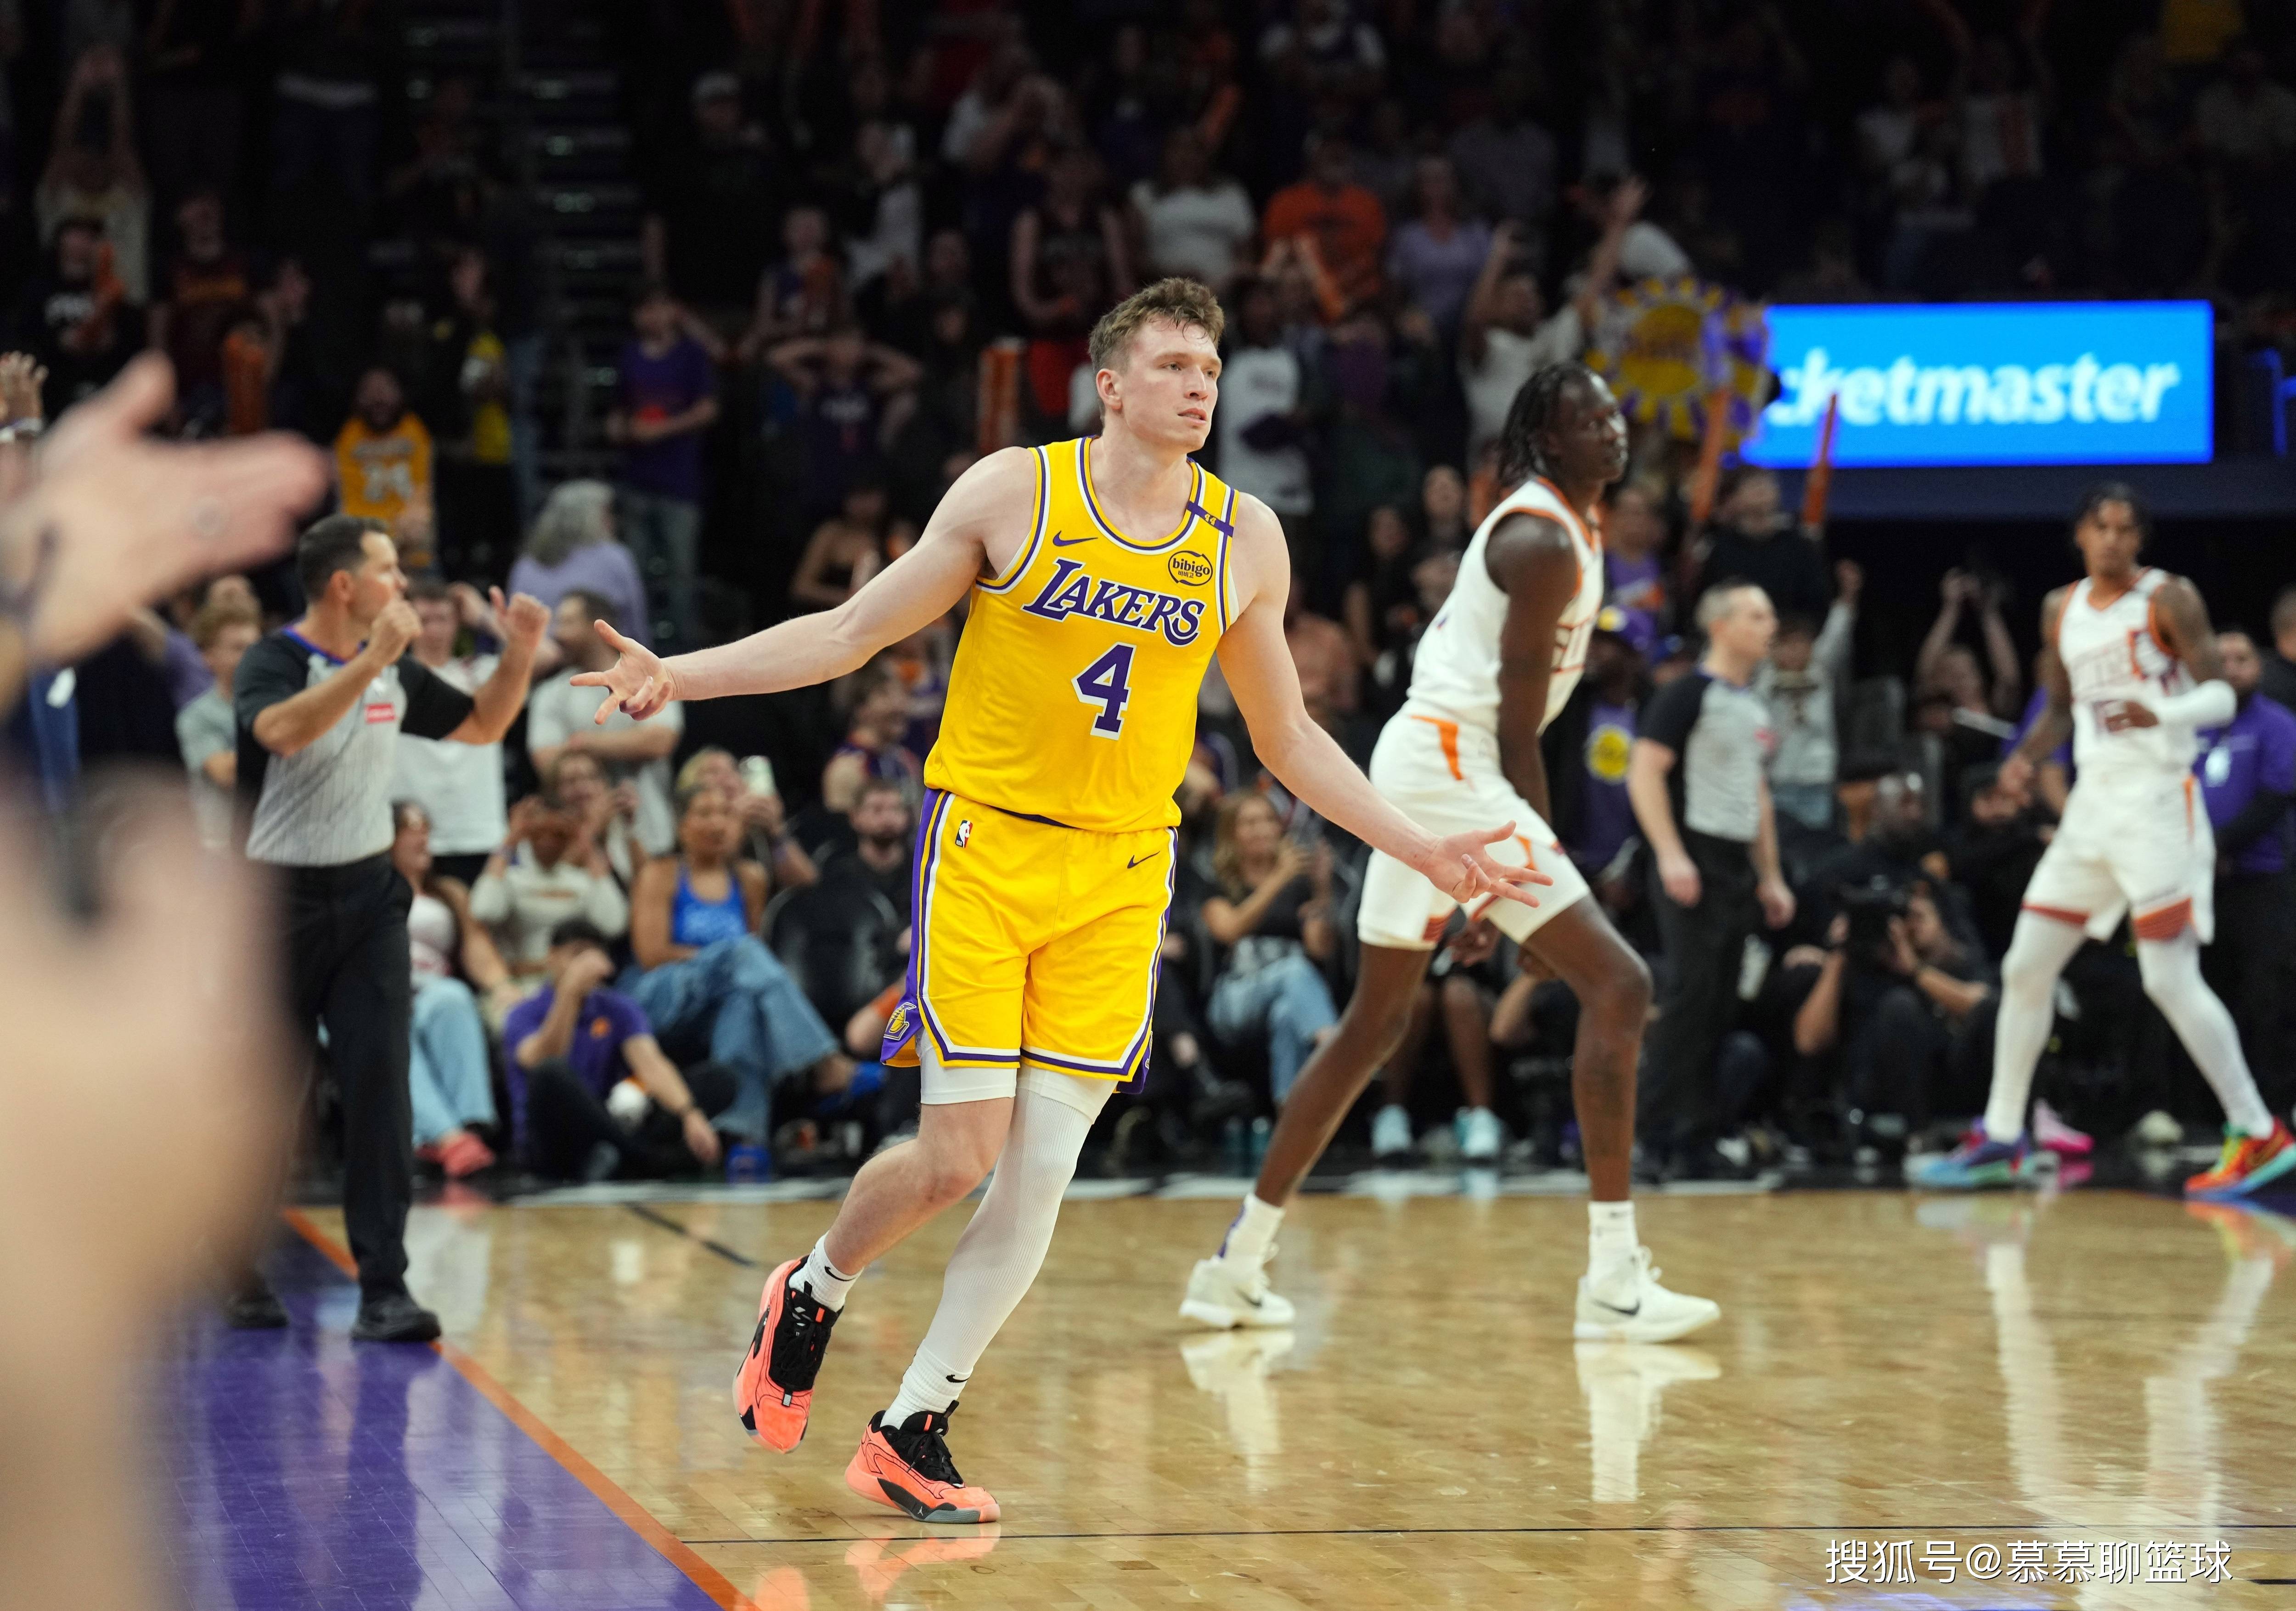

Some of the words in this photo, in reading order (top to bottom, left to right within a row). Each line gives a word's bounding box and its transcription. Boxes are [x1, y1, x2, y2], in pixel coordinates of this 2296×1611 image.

[1172, 558, 1210, 577] bibigo
[1178, 570, 1194, 578] 비비고
[1020, 556, 1206, 647] LAKERS
[1071, 642, 1137, 740] 4
